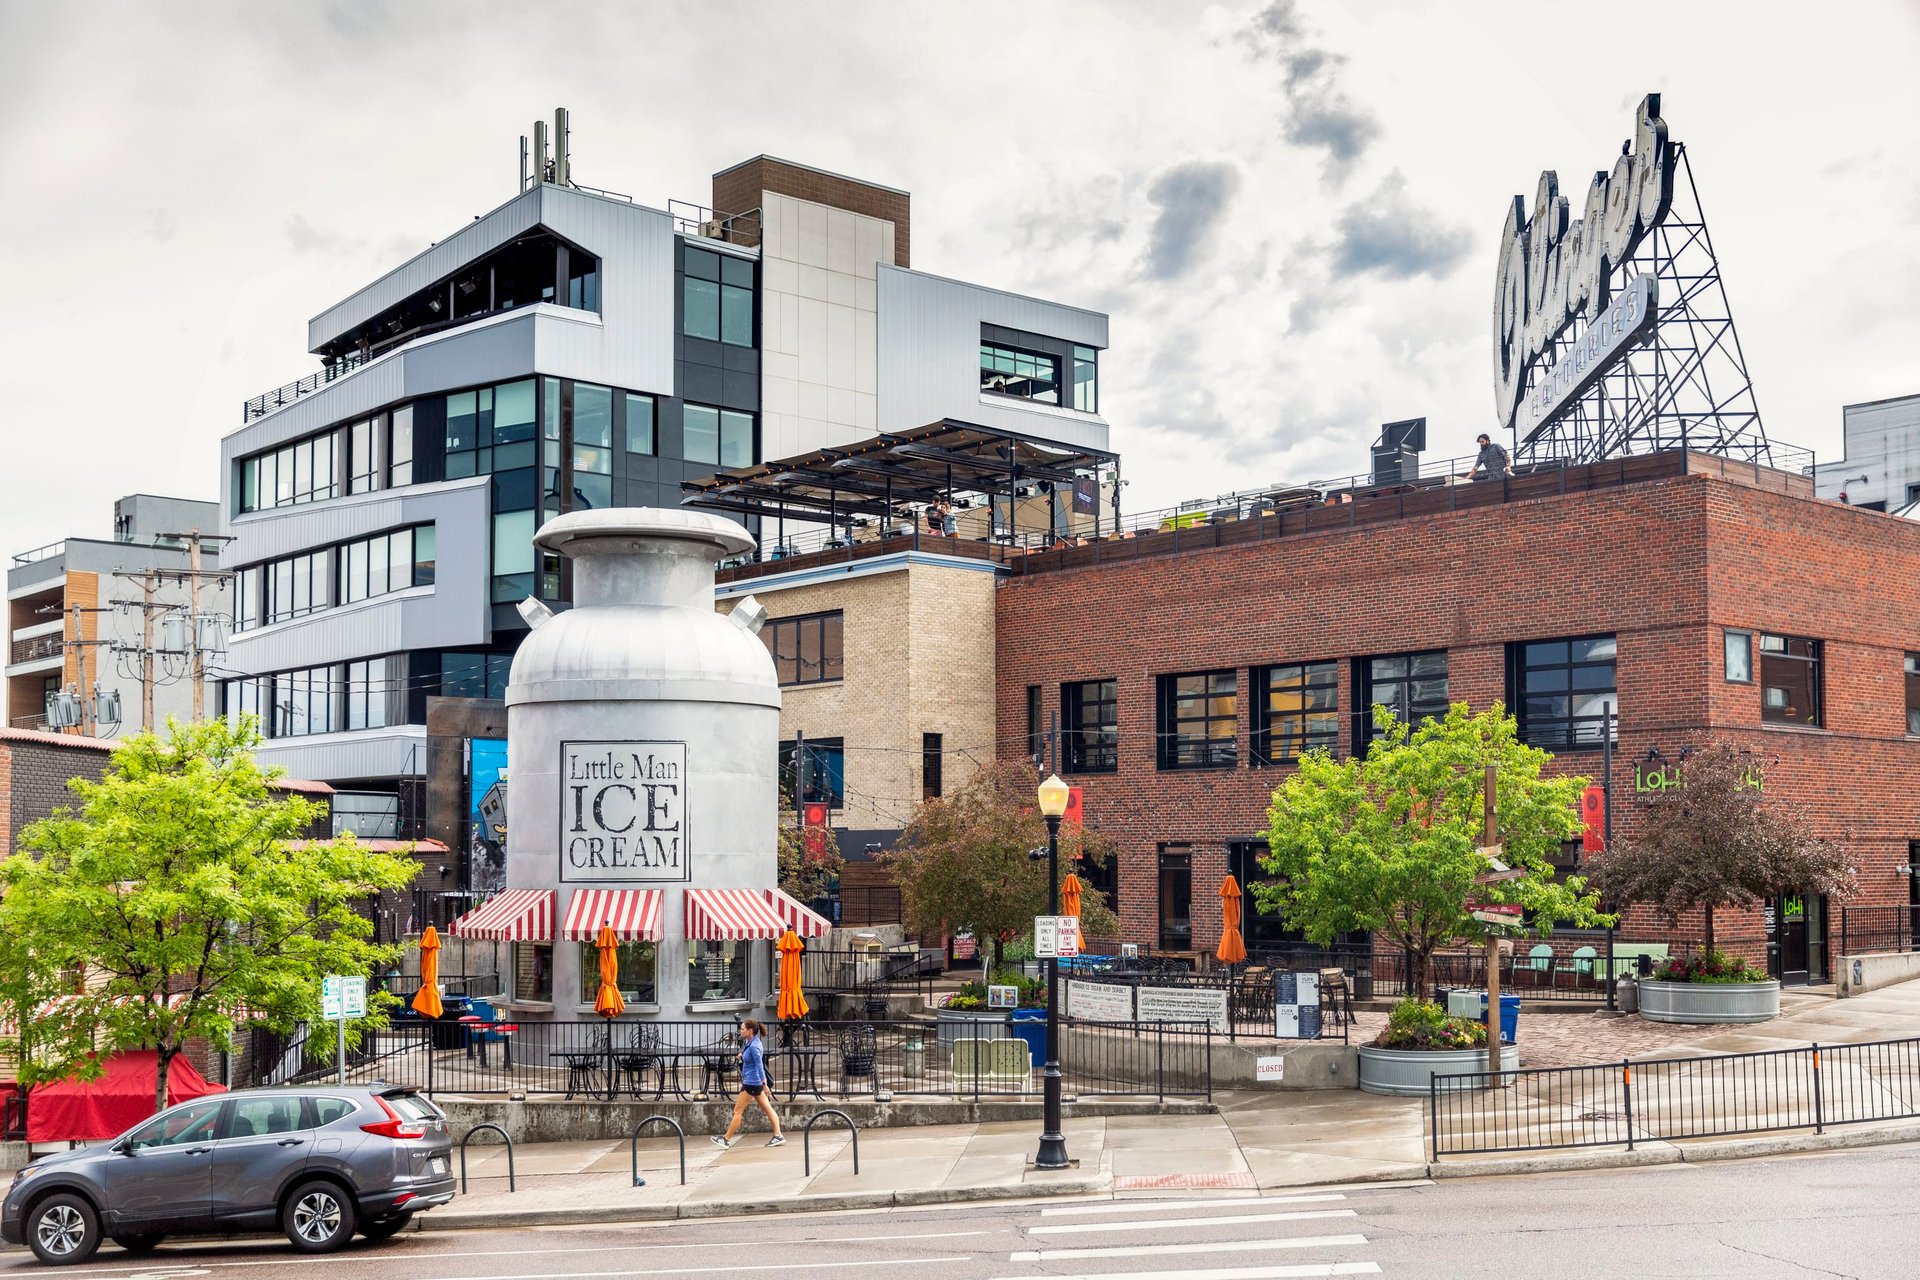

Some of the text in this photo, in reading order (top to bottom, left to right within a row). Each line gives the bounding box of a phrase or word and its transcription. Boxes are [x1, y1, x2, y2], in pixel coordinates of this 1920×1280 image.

[570, 752, 679, 780] Little Man
[570, 784, 679, 833] ICE
[569, 836, 680, 868] CREAM
[1257, 1064, 1282, 1072] CLOSED
